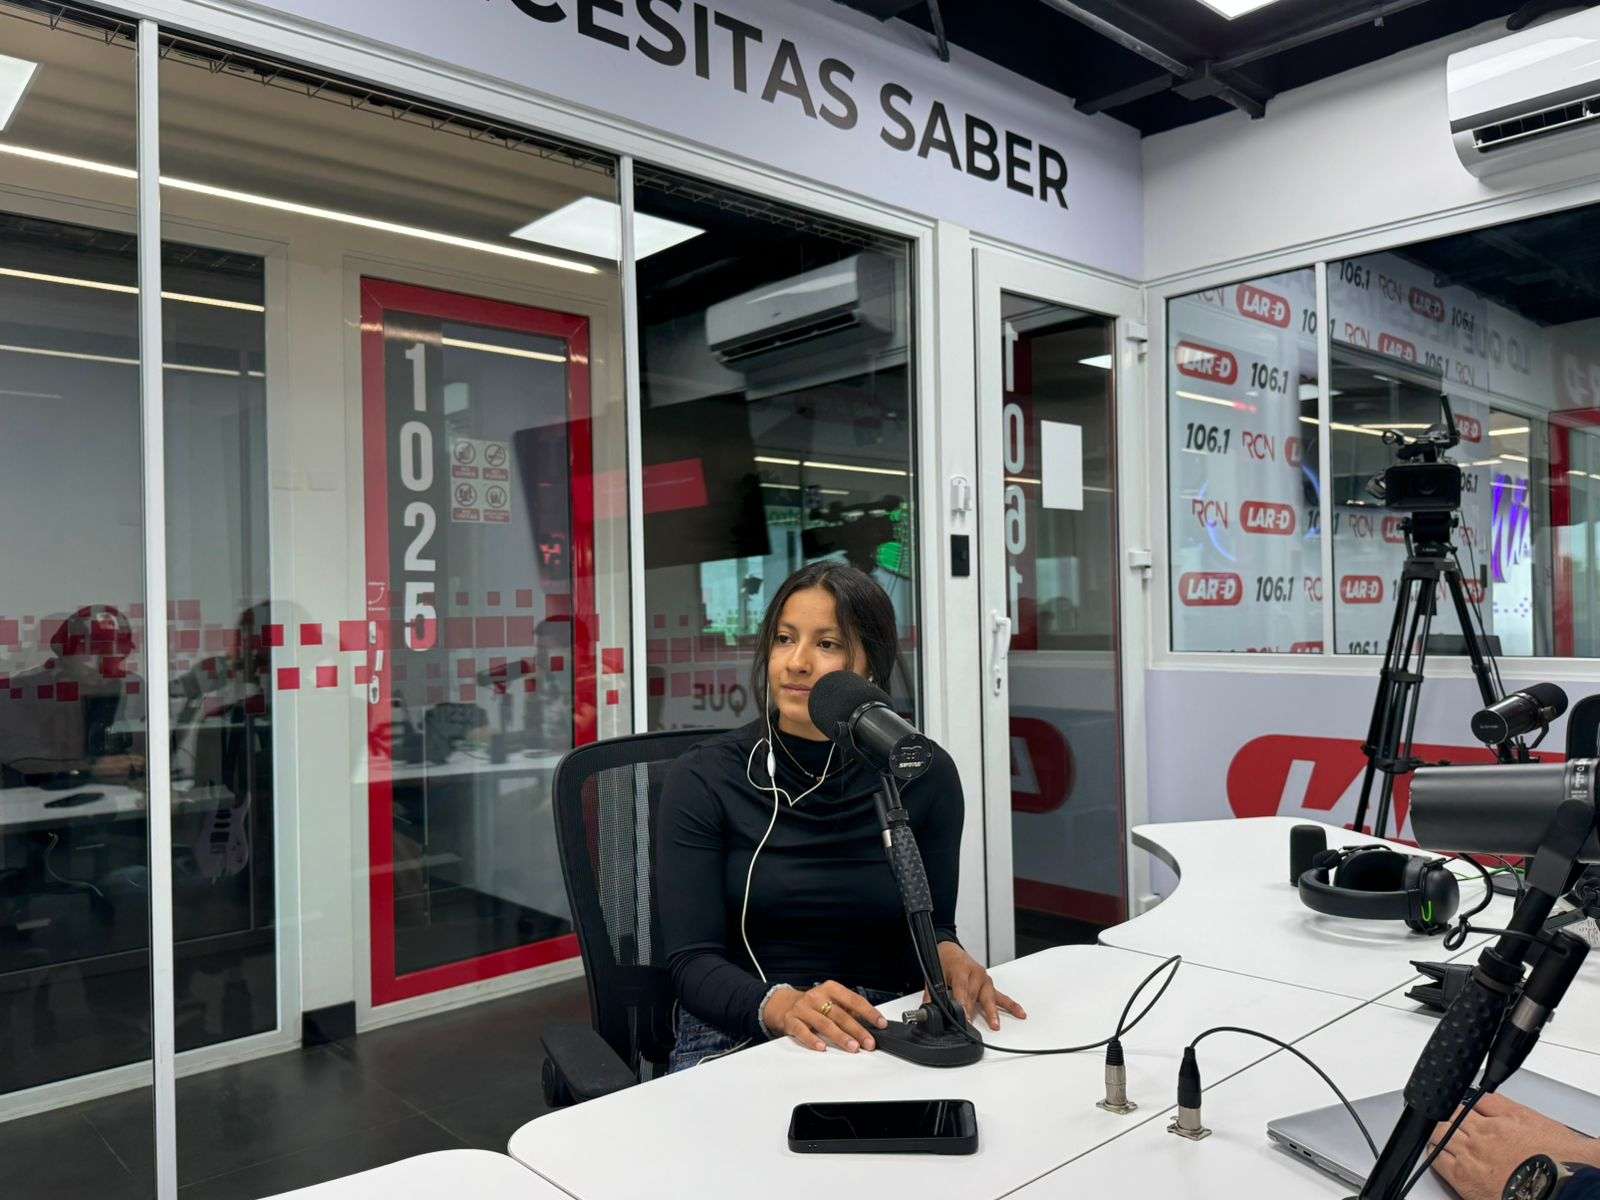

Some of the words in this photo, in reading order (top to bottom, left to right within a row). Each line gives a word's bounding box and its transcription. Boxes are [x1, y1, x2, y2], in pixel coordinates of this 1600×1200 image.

[879, 82, 1070, 210] SABER
[1339, 260, 1371, 291] 106.1
[1344, 321, 1371, 350] RCN
[1250, 361, 1290, 395] 106.1
[1184, 422, 1231, 454] 106.1
[1242, 431, 1275, 462] RCN
[1191, 498, 1229, 529] RCN
[1255, 576, 1295, 602] 106.1
[1303, 576, 1324, 601] RC
